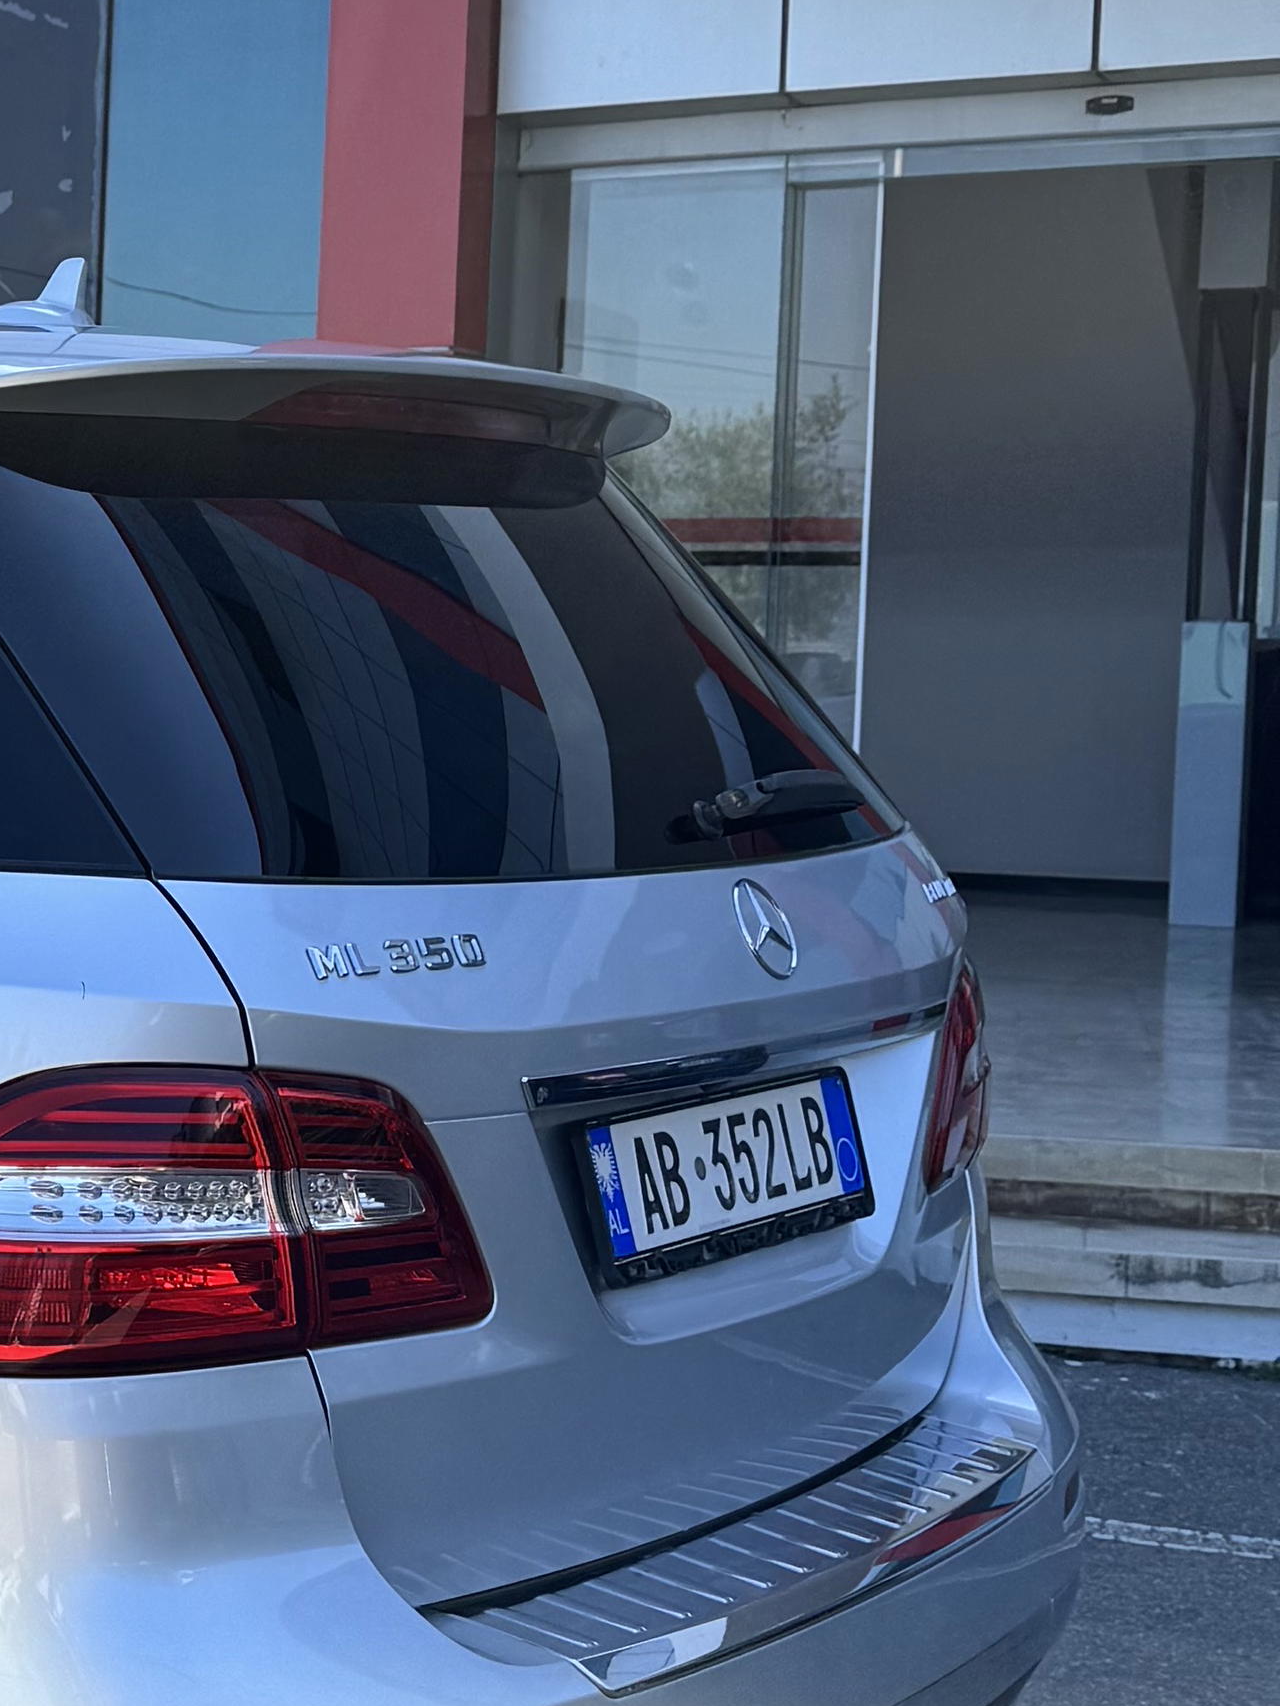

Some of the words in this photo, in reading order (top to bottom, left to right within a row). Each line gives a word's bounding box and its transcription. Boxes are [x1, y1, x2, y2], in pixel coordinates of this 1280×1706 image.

[305, 943, 381, 981] ML
[382, 933, 487, 974] 350
[633, 1130, 691, 1235] AB
[608, 1209, 630, 1238] AL
